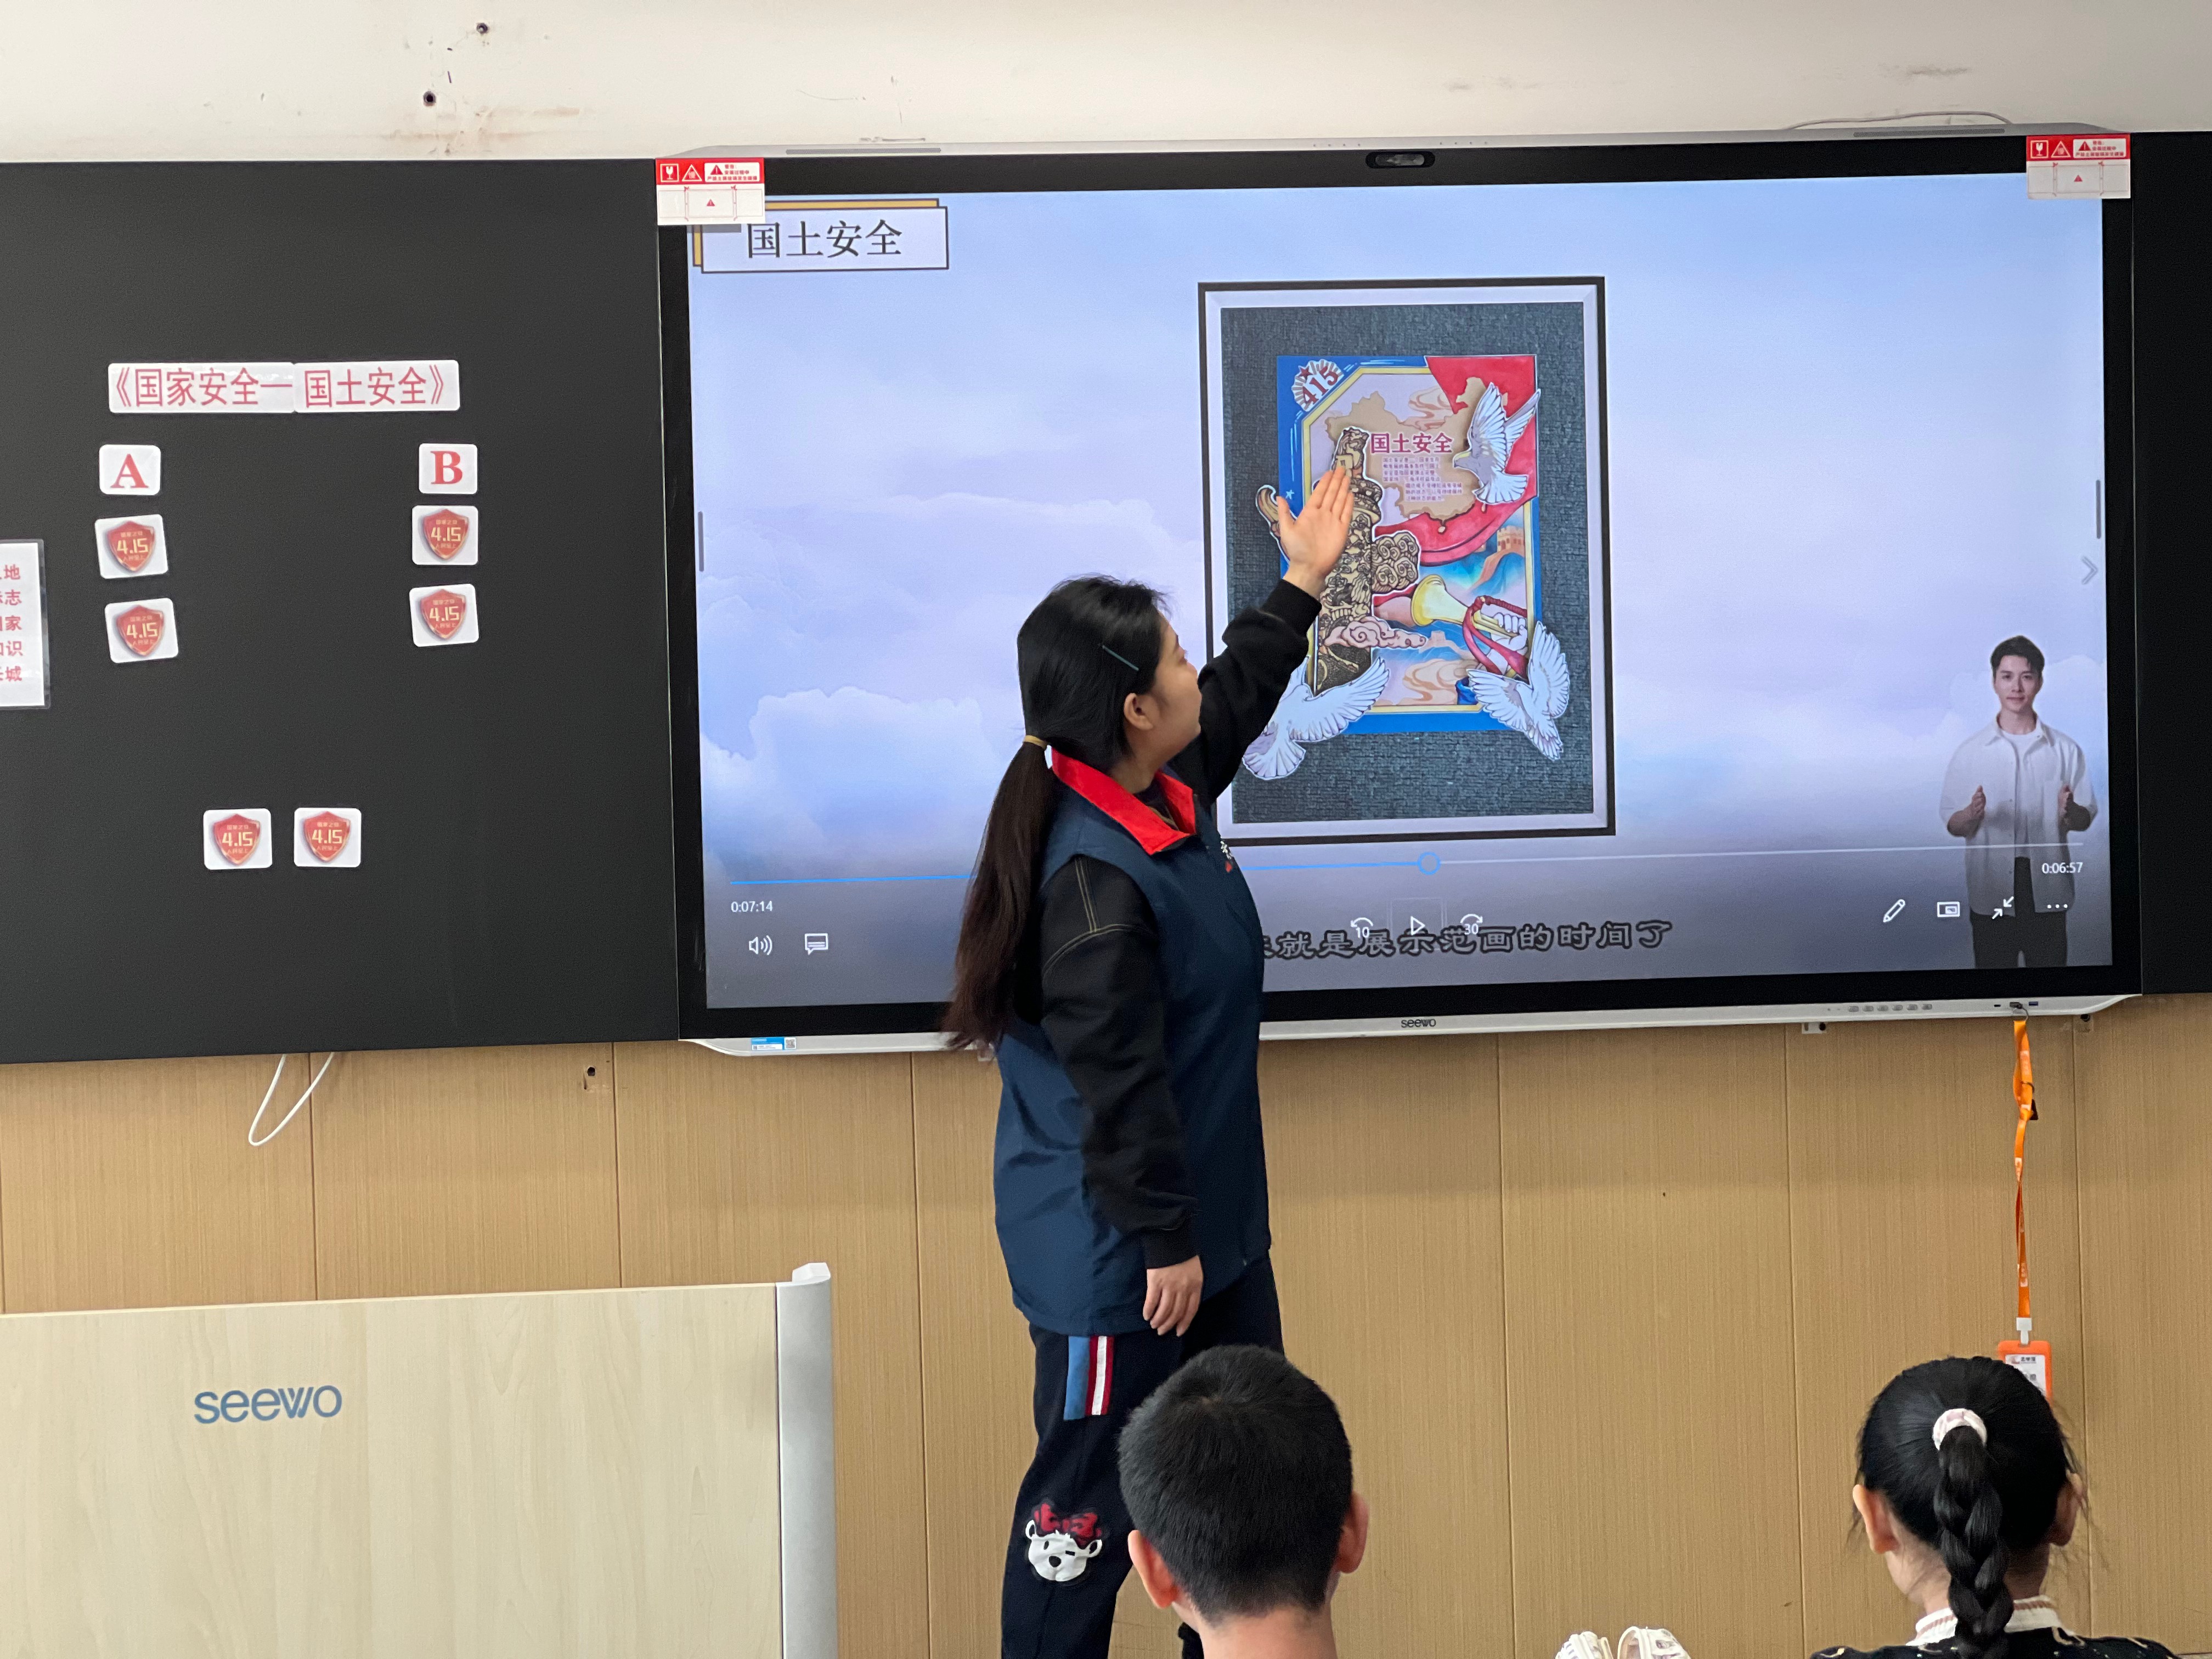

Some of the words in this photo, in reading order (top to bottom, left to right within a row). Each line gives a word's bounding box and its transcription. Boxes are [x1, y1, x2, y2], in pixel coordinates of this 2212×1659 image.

[747, 219, 903, 258] 国土安全
[1302, 365, 1339, 405] 415
[1371, 432, 1453, 454] 国土安全
[110, 453, 149, 489] A
[430, 450, 464, 484] B
[430, 527, 461, 541] 4.15
[116, 538, 149, 555] 4.15
[0, 563, 21, 580] 地
[0, 589, 22, 606] 志
[429, 606, 460, 622] 4.15
[0, 615, 22, 631] 家
[126, 622, 159, 639] 4.15
[0, 665, 22, 682] 城
[222, 831, 253, 847] 4.15
[312, 829, 343, 844] 4.15
[2041, 862, 2084, 874] 0:06:57
[730, 900, 774, 912] 0:07:14
[1355, 926, 1371, 939] 10
[1464, 923, 1480, 935] 30
[1401, 1018, 1437, 1028] seewo
[194, 1384, 343, 1425] seewo
